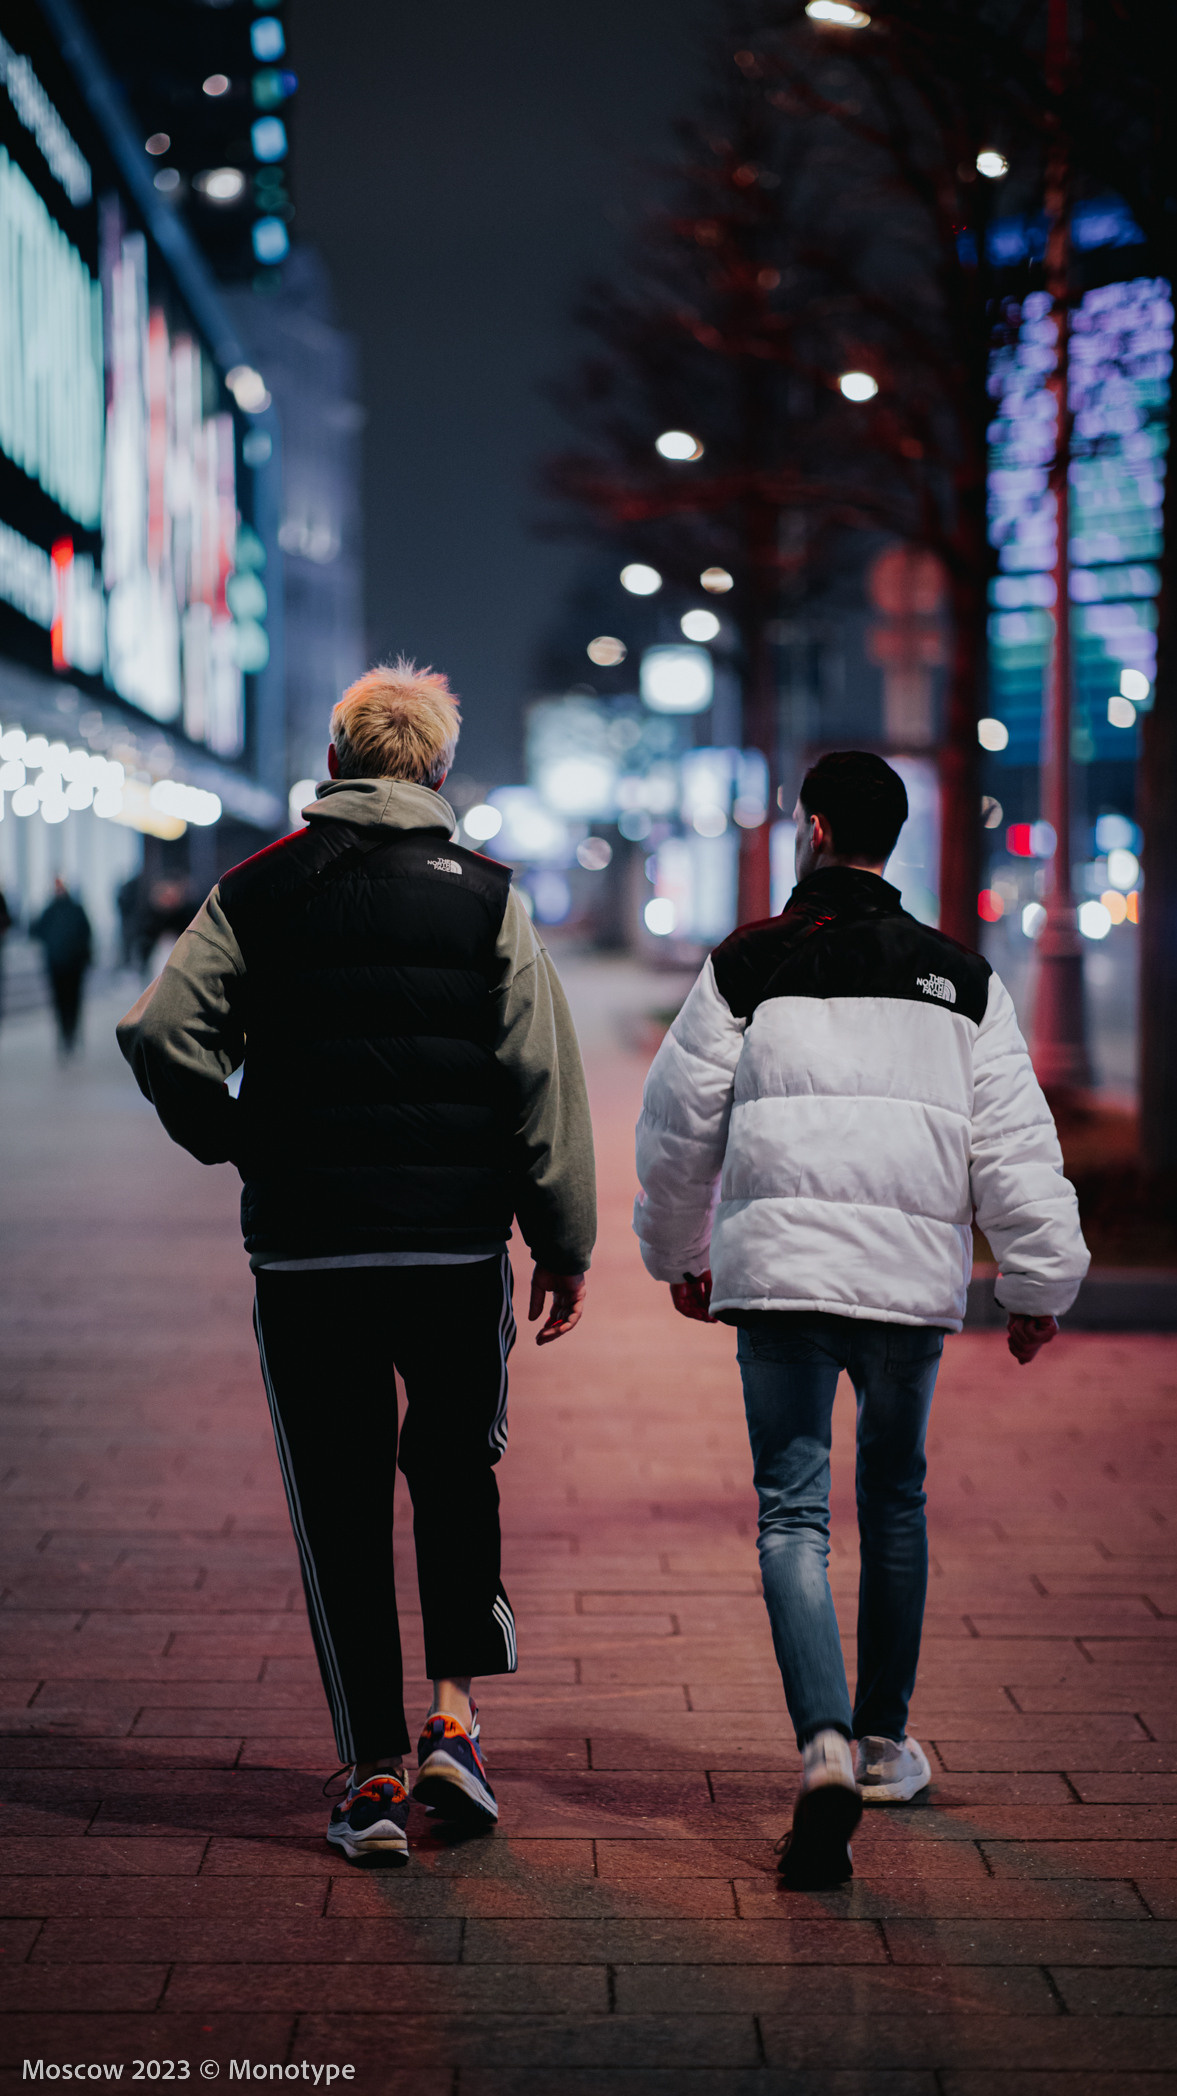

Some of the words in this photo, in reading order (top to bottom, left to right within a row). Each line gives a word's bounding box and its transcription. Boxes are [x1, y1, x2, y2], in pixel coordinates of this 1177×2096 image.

[916, 977, 944, 993] NORTH
[929, 973, 945, 985] THE
[922, 985, 944, 999] FACE
